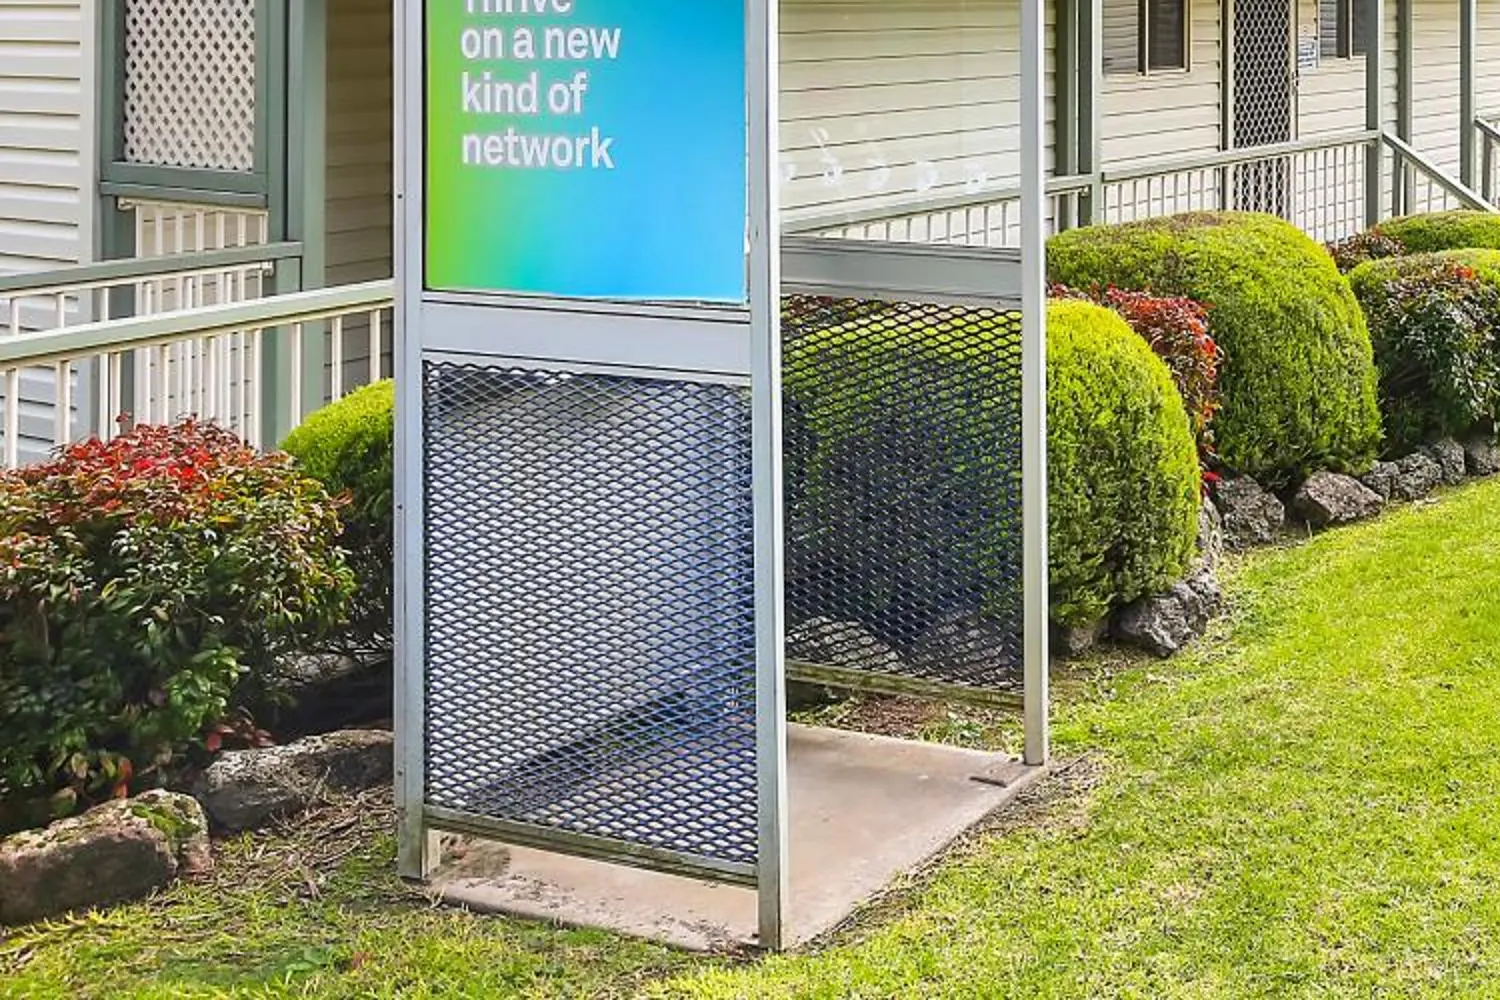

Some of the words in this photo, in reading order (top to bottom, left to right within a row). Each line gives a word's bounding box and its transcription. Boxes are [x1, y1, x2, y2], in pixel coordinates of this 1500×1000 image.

[461, 27, 503, 59] on
[513, 27, 535, 59] a
[545, 27, 622, 59] new
[462, 72, 538, 113] kind
[549, 72, 588, 113] of
[462, 126, 616, 169] network
